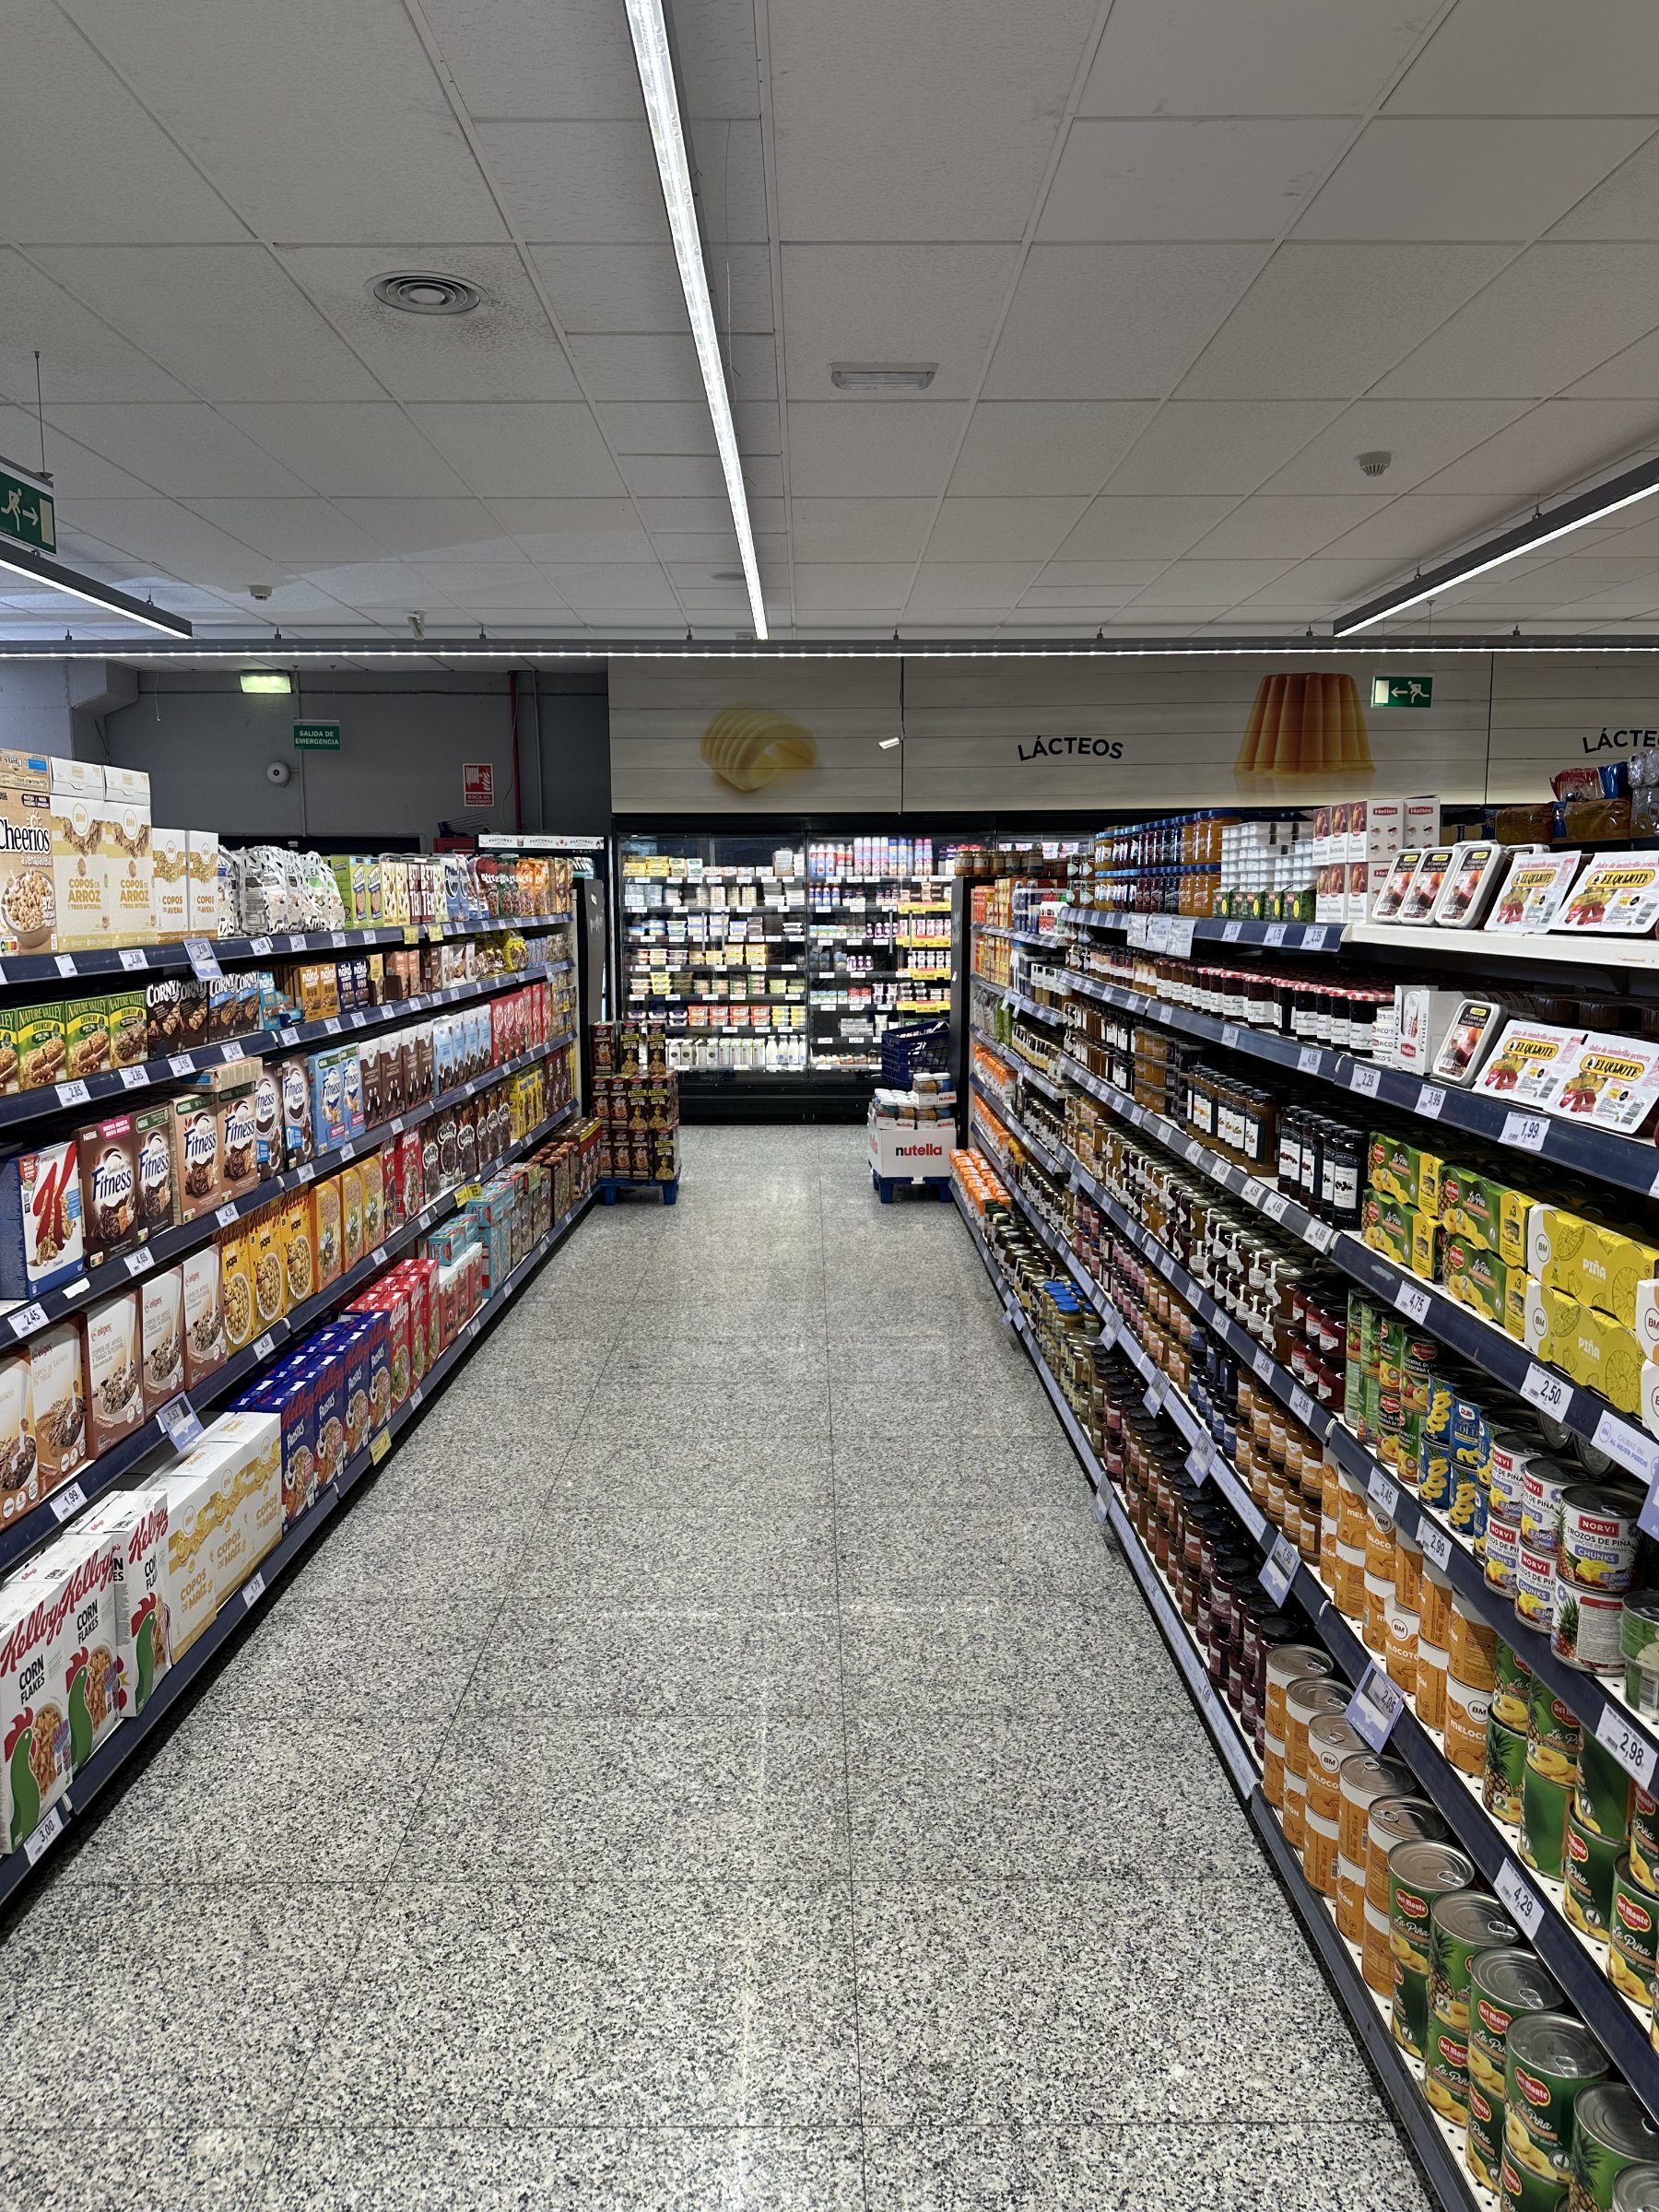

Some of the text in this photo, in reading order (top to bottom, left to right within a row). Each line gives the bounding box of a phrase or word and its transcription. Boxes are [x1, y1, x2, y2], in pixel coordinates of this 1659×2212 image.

[1018, 735, 1124, 761] LÁCTEOS
[1583, 728, 1659, 753] LÁCTE
[68, 878, 100, 888] COPOS DE
[120, 879, 144, 889] COPOS
[67, 889, 101, 903] ARROZ
[120, 890, 149, 902] ARROZ
[162, 895, 183, 905] COPOS
[196, 895, 215, 905] COPOS
[167, 906, 183, 914] AVENA
[147, 980, 180, 1007] CORNY
[209, 973, 237, 998] CORNY
[67, 998, 107, 1019] NATURE VALLEY
[109, 993, 145, 1012] NATURE VALLEY
[18, 1004, 64, 1024] NATURE VALLEY
[80, 1015, 98, 1025] CRUNCHY
[121, 1008, 137, 1018] CRUNCHY
[32, 1021, 53, 1032] CRUNCHY
[1524, 1043, 1556, 1058] QUIJOTE
[343, 1065, 360, 1089] Fitness
[1605, 1062, 1641, 1078] QUIJOTE
[68, 1086, 83, 1098] 2,85
[284, 1077, 304, 1100] Fitness
[322, 1076, 341, 1100] Fitness
[255, 1092, 275, 1108] itness
[1428, 1091, 1441, 1106] 3,99
[224, 1115, 255, 1145] Fitness
[1522, 1122, 1539, 1140] 1,99
[183, 1128, 217, 1159] Fitness
[895, 1143, 943, 1157] nutella
[138, 1149, 170, 1182] Fitness
[90, 1166, 132, 1202] Fitness
[1537, 1242, 1547, 1253] BM
[1583, 1258, 1606, 1280] PIÑA
[149, 1296, 163, 1309] eliges
[1409, 1292, 1424, 1312] 4,75
[23, 1311, 41, 1325] 2,45
[1535, 1317, 1545, 1327] BM
[97, 1323, 112, 1337] eliges
[37, 1342, 53, 1359] eliges
[1578, 1335, 1600, 1359] PIÑA
[1540, 1380, 1561, 1405] 2,50
[1498, 1468, 1506, 1477] DE
[64, 1489, 78, 1507] 1,99
[1382, 1483, 1393, 1505] 3,45
[255, 1492, 278, 1521] COPOS
[1377, 1518, 1388, 1526] BM
[1583, 1520, 1615, 1534] NORVI
[217, 1528, 242, 1557] COPOS
[1490, 1525, 1514, 1541] NORVI
[1566, 1526, 1631, 1547] TROZOS DE PIÑA
[1430, 1535, 1445, 1558] 2,99
[1499, 1542, 1509, 1550] DE
[1578, 1547, 1615, 1562] CHUNKS
[218, 1544, 242, 1571] DE MAÍZ
[1488, 1548, 1512, 1566] CHUNKS
[1522, 1555, 1547, 1571] NORVI
[180, 1567, 206, 1602] COPOS
[1532, 1572, 1543, 1583] DE
[181, 1582, 207, 1614] DE MAÍZ
[1519, 1582, 1547, 1599] CHUNKS
[76, 1598, 98, 1630] CORN
[77, 1615, 99, 1645] FLAKES
[1394, 1624, 1405, 1633] BM
[19, 1653, 45, 1690] CORN
[20, 1671, 45, 1706] FLAKES
[1382, 1689, 1396, 1713] 2,05
[1472, 1706, 1487, 1716] BM
[1450, 1720, 1487, 1740] MELOCO
[1547, 1729, 1563, 1741] La
[1619, 1733, 1644, 1767] 2,98
[1323, 1756, 1336, 1766] BM
[39, 1819, 55, 1842] 3,00
[1635, 1818, 1656, 1841] Piña
[1568, 1864, 1589, 1886] Piña
[1396, 1894, 1427, 1912] Del Monte
[1513, 1888, 1533, 1918] 4,29
[1618, 1900, 1649, 1925] Del Monte
[1394, 1915, 1430, 1937] La Piña
[1624, 1934, 1653, 1958] Piña
[1479, 2005, 1509, 2028] Del Mont
[1475, 2030, 1488, 2043] La
[1440, 2040, 1467, 2061] Del Mon
[1435, 2064, 1447, 2077] La
[1515, 2071, 1548, 2100] Del Monte
[1526, 2108, 1553, 2131] Piña
